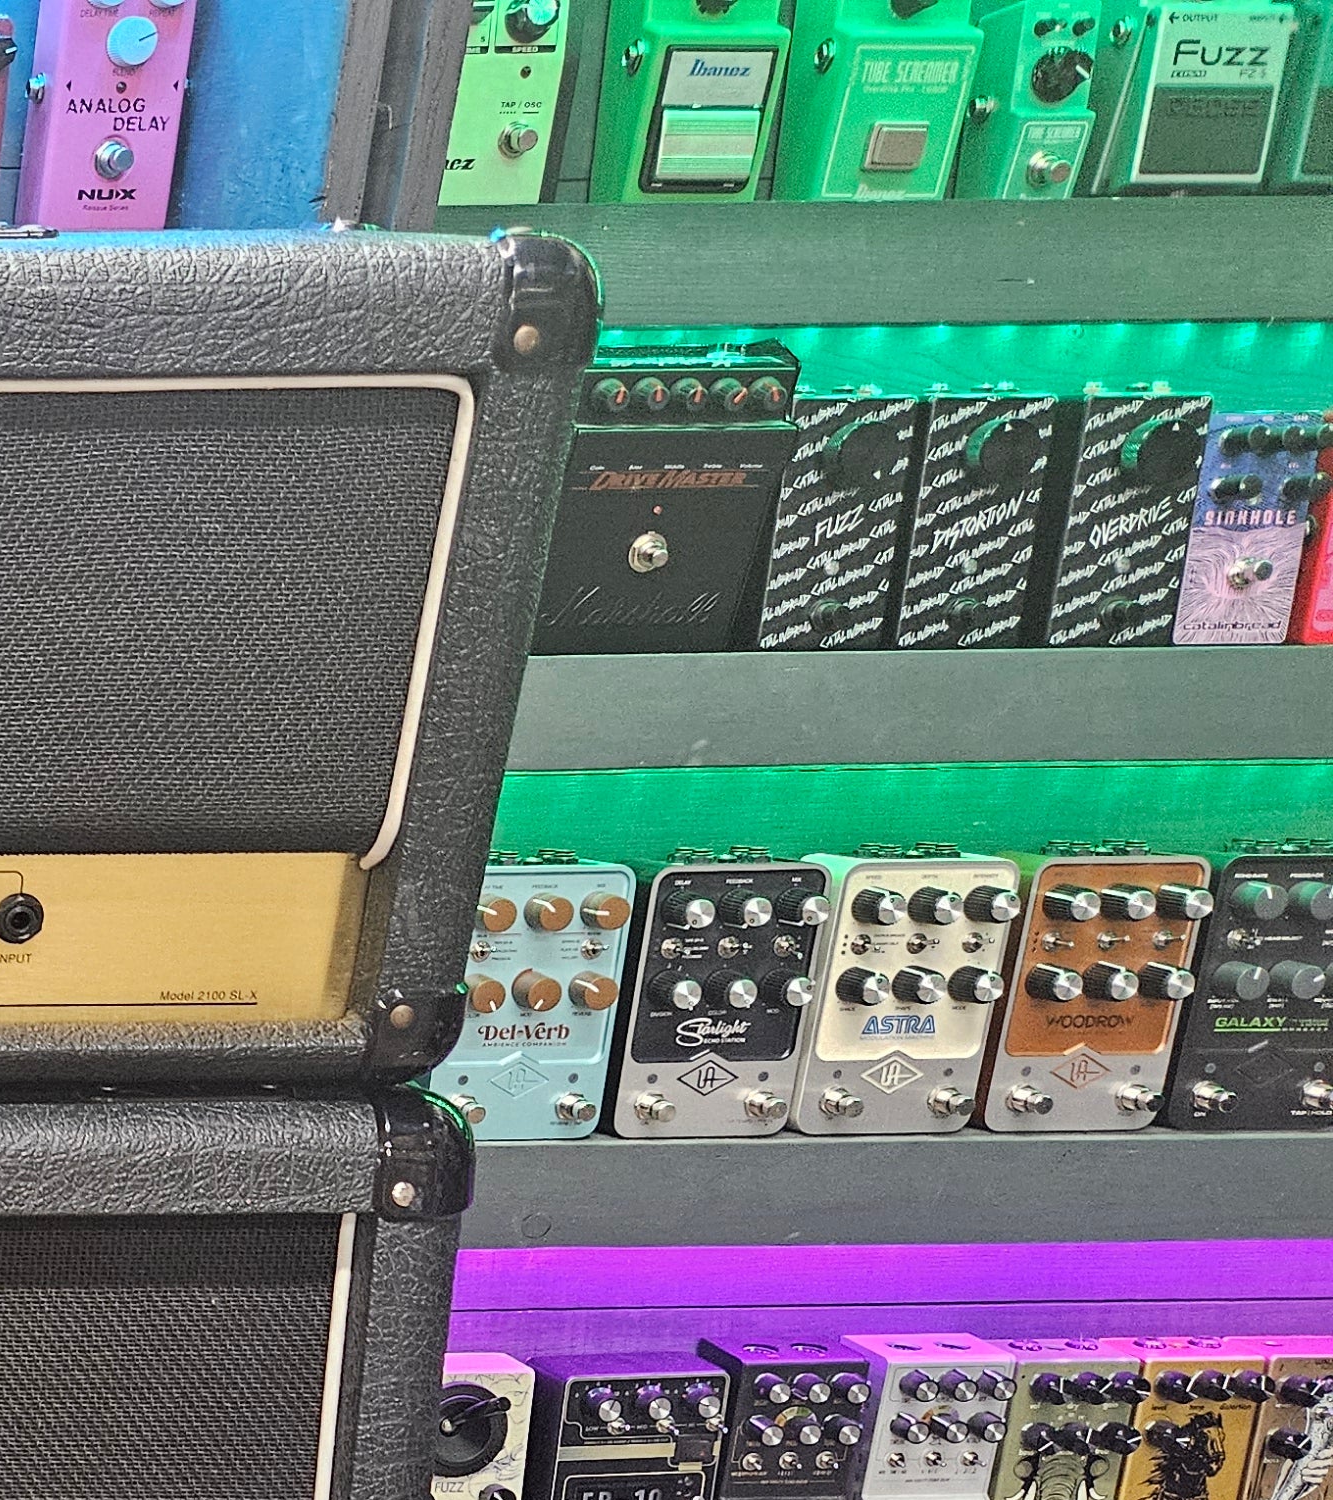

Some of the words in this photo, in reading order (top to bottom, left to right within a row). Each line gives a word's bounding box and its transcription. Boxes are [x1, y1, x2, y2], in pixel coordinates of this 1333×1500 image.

[1182, 13, 1219, 22] OUTPUT
[688, 58, 751, 78] Ibanez
[861, 60, 893, 84] TUBE
[894, 60, 960, 84] SCREAMER
[65, 97, 147, 114] ANALOG
[500, 101, 517, 109] TAP
[112, 115, 171, 132] DELAY
[77, 188, 138, 201] NUX
[813, 503, 866, 547] FUZZ
[929, 490, 1025, 555] DISTORTION
[1088, 496, 1174, 550] OVERDRIVE
[1182, 619, 1282, 632] catalinbread
[159, 990, 195, 1001] Model
[197, 990, 226, 1001] 2100
[229, 989, 258, 1001] SL-X
[861, 1014, 936, 1035] ASTRA
[1046, 1013, 1134, 1028] WOODROW
[1215, 1016, 1287, 1028] GALAXY
[477, 1023, 571, 1042] Del-Verb
[676, 1017, 752, 1047] Starlight
[434, 1481, 465, 1493] FUZZ
